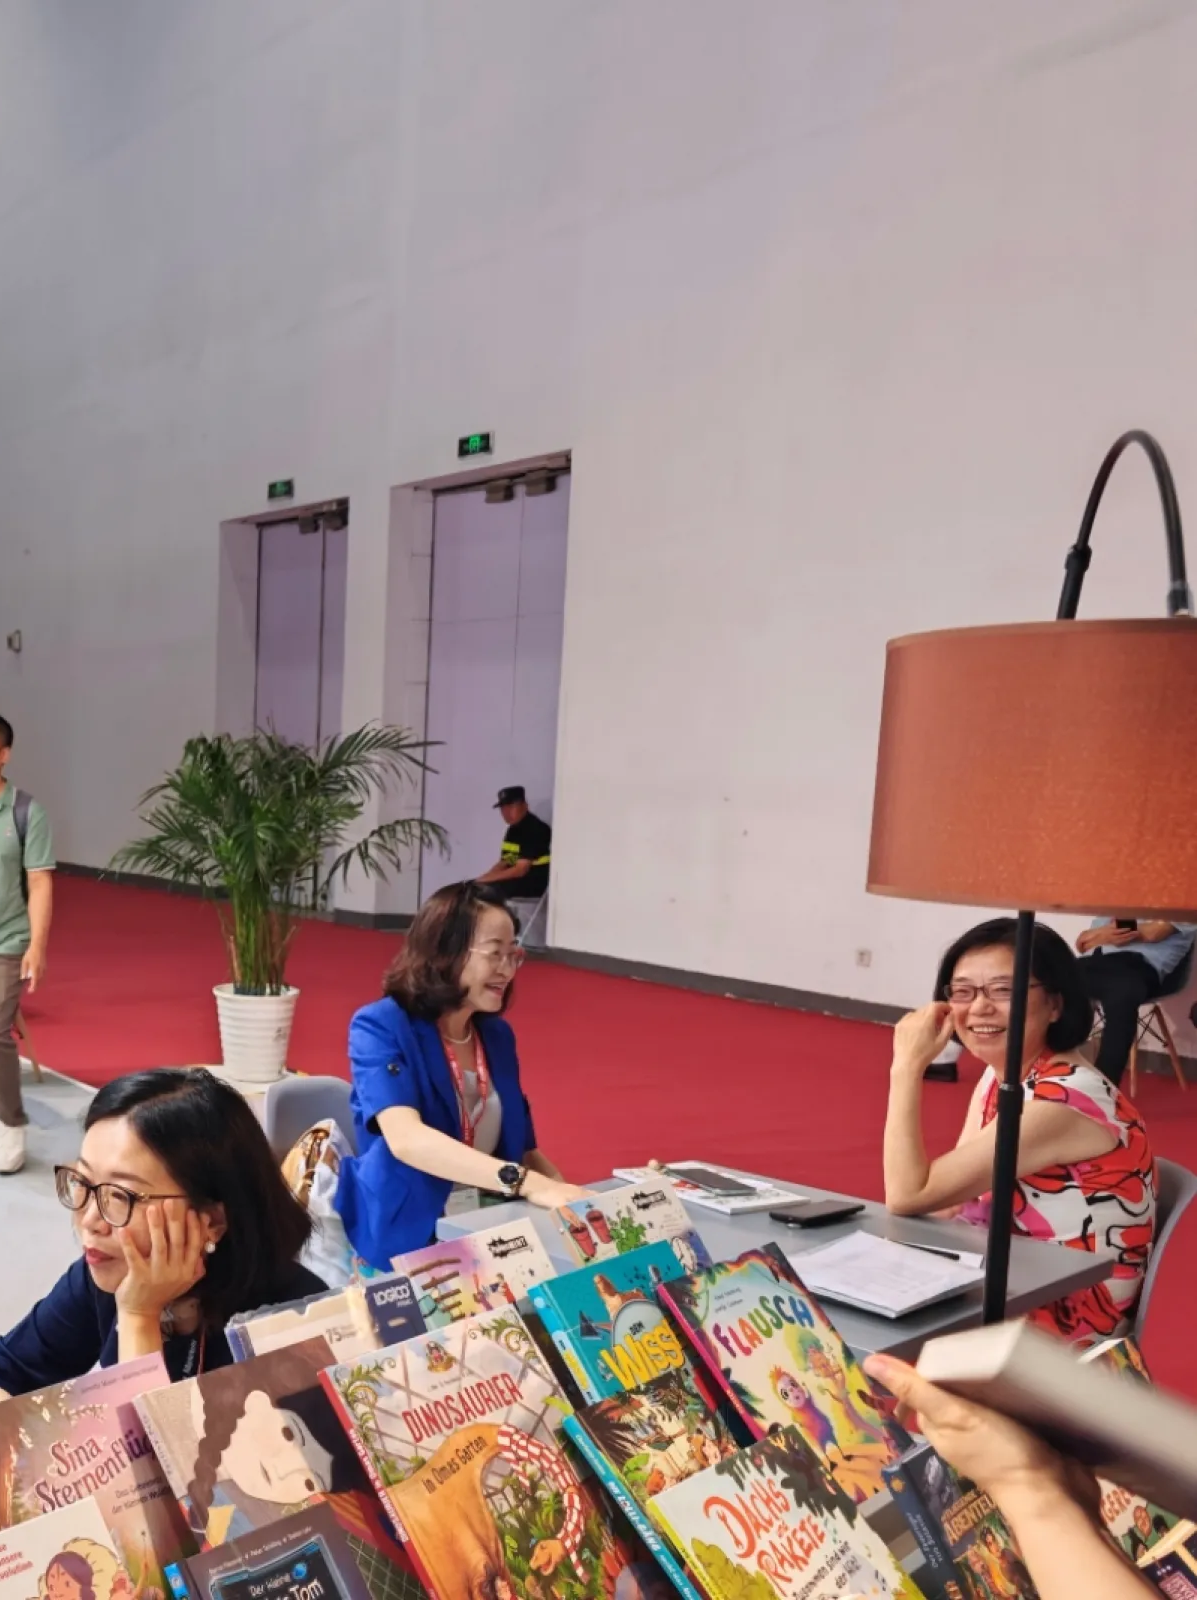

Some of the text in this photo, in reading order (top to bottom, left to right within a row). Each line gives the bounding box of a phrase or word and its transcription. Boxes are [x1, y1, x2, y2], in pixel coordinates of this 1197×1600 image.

[373, 1284, 410, 1306] LOGICO
[713, 1294, 815, 1358] FLAUSCH
[402, 1373, 524, 1443] DINOSAURIER
[50, 1437, 103, 1477] Sina
[456, 1436, 489, 1465] Garten
[703, 1478, 791, 1559] DACHS
[757, 1514, 826, 1598] RAKETE
[290, 1577, 324, 1600] Tom
